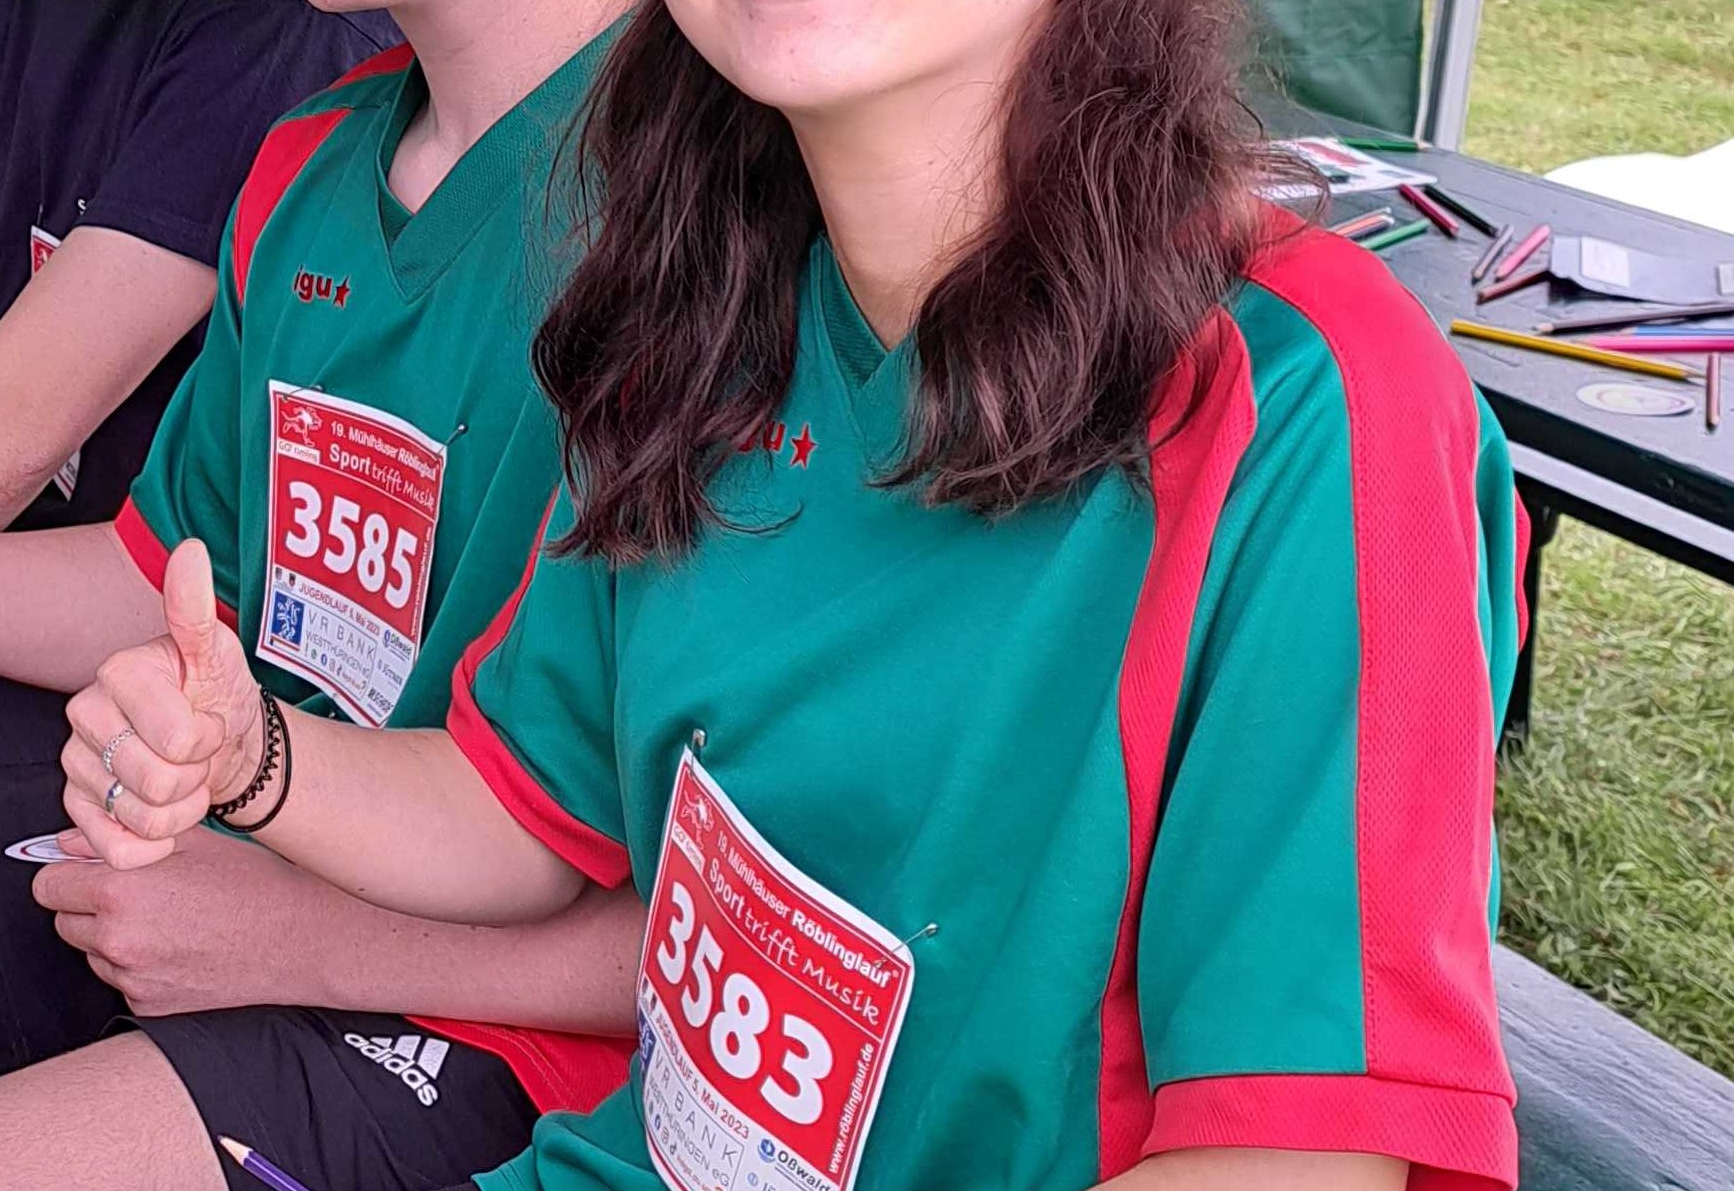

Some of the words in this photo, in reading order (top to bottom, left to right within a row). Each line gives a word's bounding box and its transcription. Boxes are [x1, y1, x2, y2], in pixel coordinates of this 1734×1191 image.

[293, 263, 333, 303] igu
[330, 420, 347, 439] 19.
[328, 443, 371, 476] Sport
[371, 461, 404, 495] trifft
[402, 479, 436, 511] Musik
[285, 480, 419, 611] 3585
[709, 857, 746, 919] Sport
[744, 907, 801, 967] trifft
[801, 957, 880, 1027] Musik
[717, 829, 728, 858] 19.
[727, 845, 791, 920] Mühlhäuser
[791, 907, 892, 989] Röblinglauf
[656, 880, 834, 1126] 3583
[343, 1032, 439, 1108] adidas
[701, 1087, 721, 1115] Mai
[719, 1109, 751, 1140] 2023
